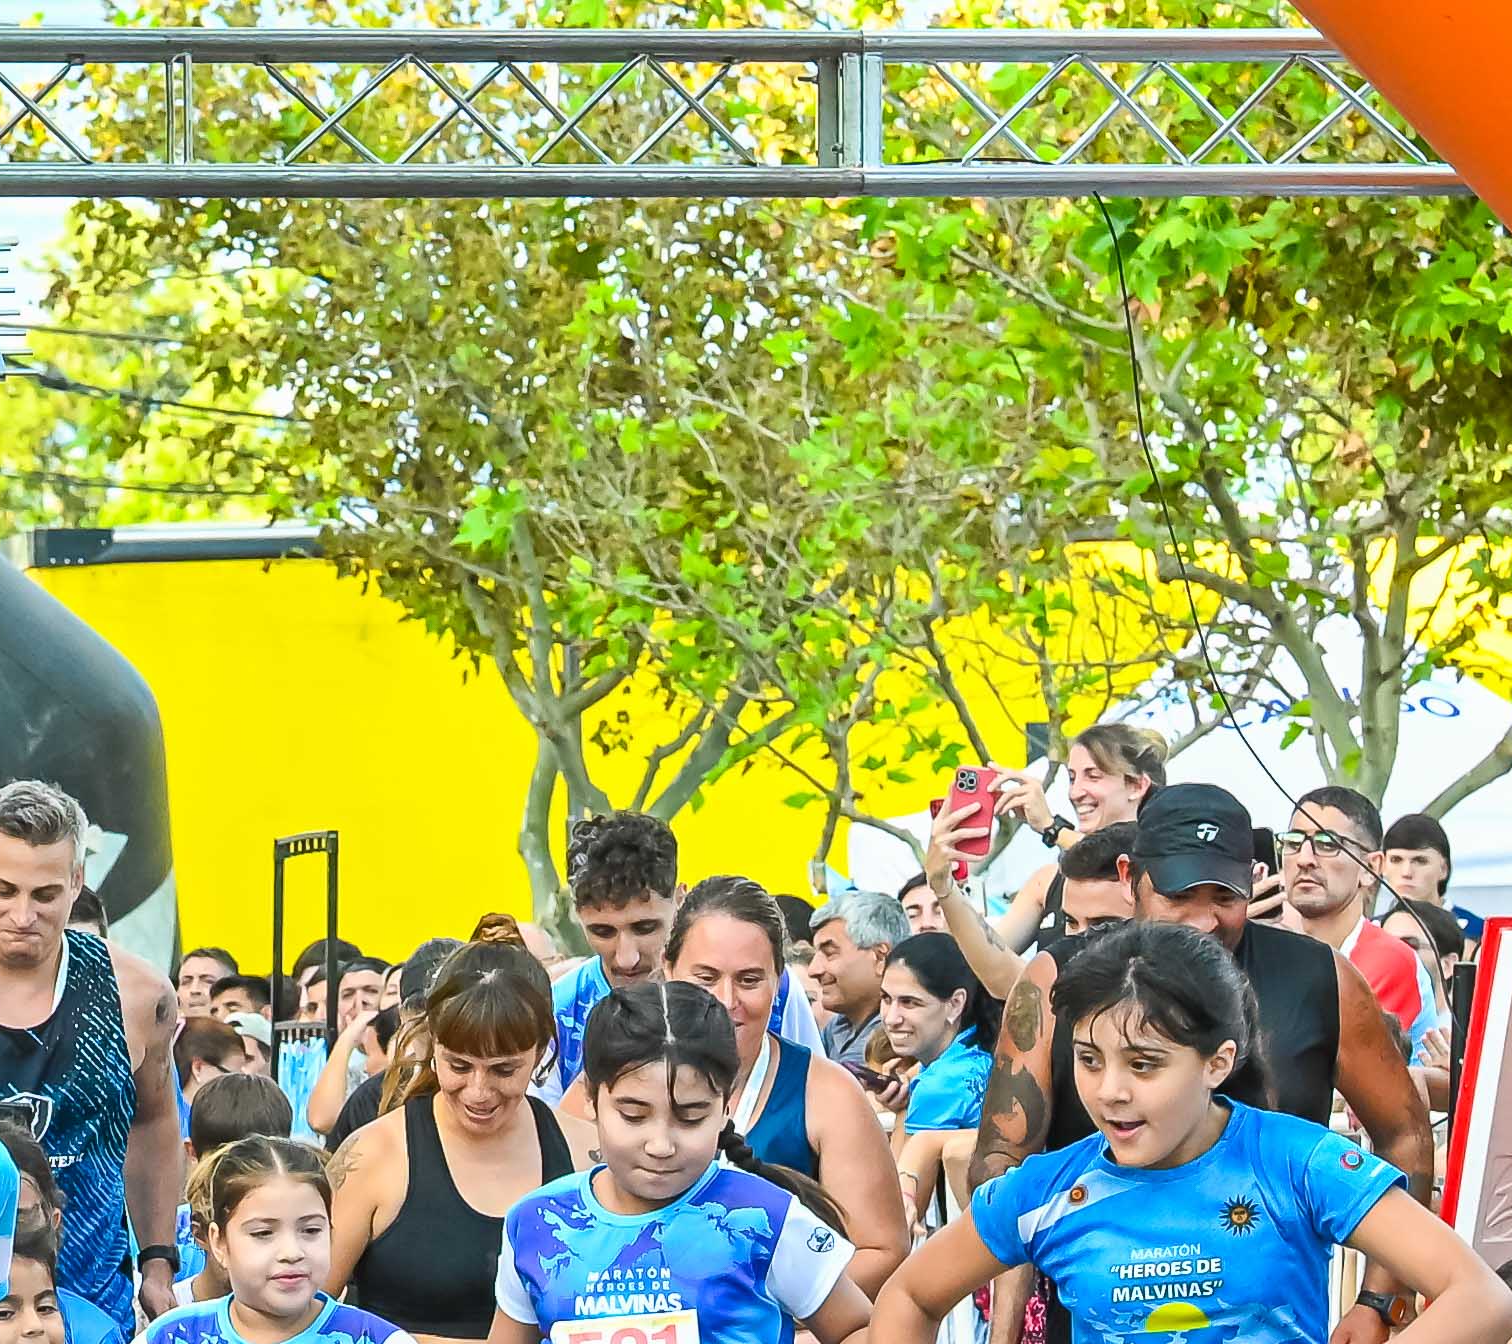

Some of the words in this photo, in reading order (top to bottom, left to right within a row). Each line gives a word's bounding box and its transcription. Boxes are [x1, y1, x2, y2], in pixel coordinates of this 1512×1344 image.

[1196, 1257, 1222, 1273] DE
[587, 1267, 671, 1282] MARATÓN
[652, 1280, 670, 1291] DE
[575, 1293, 682, 1316] MALVINAS
